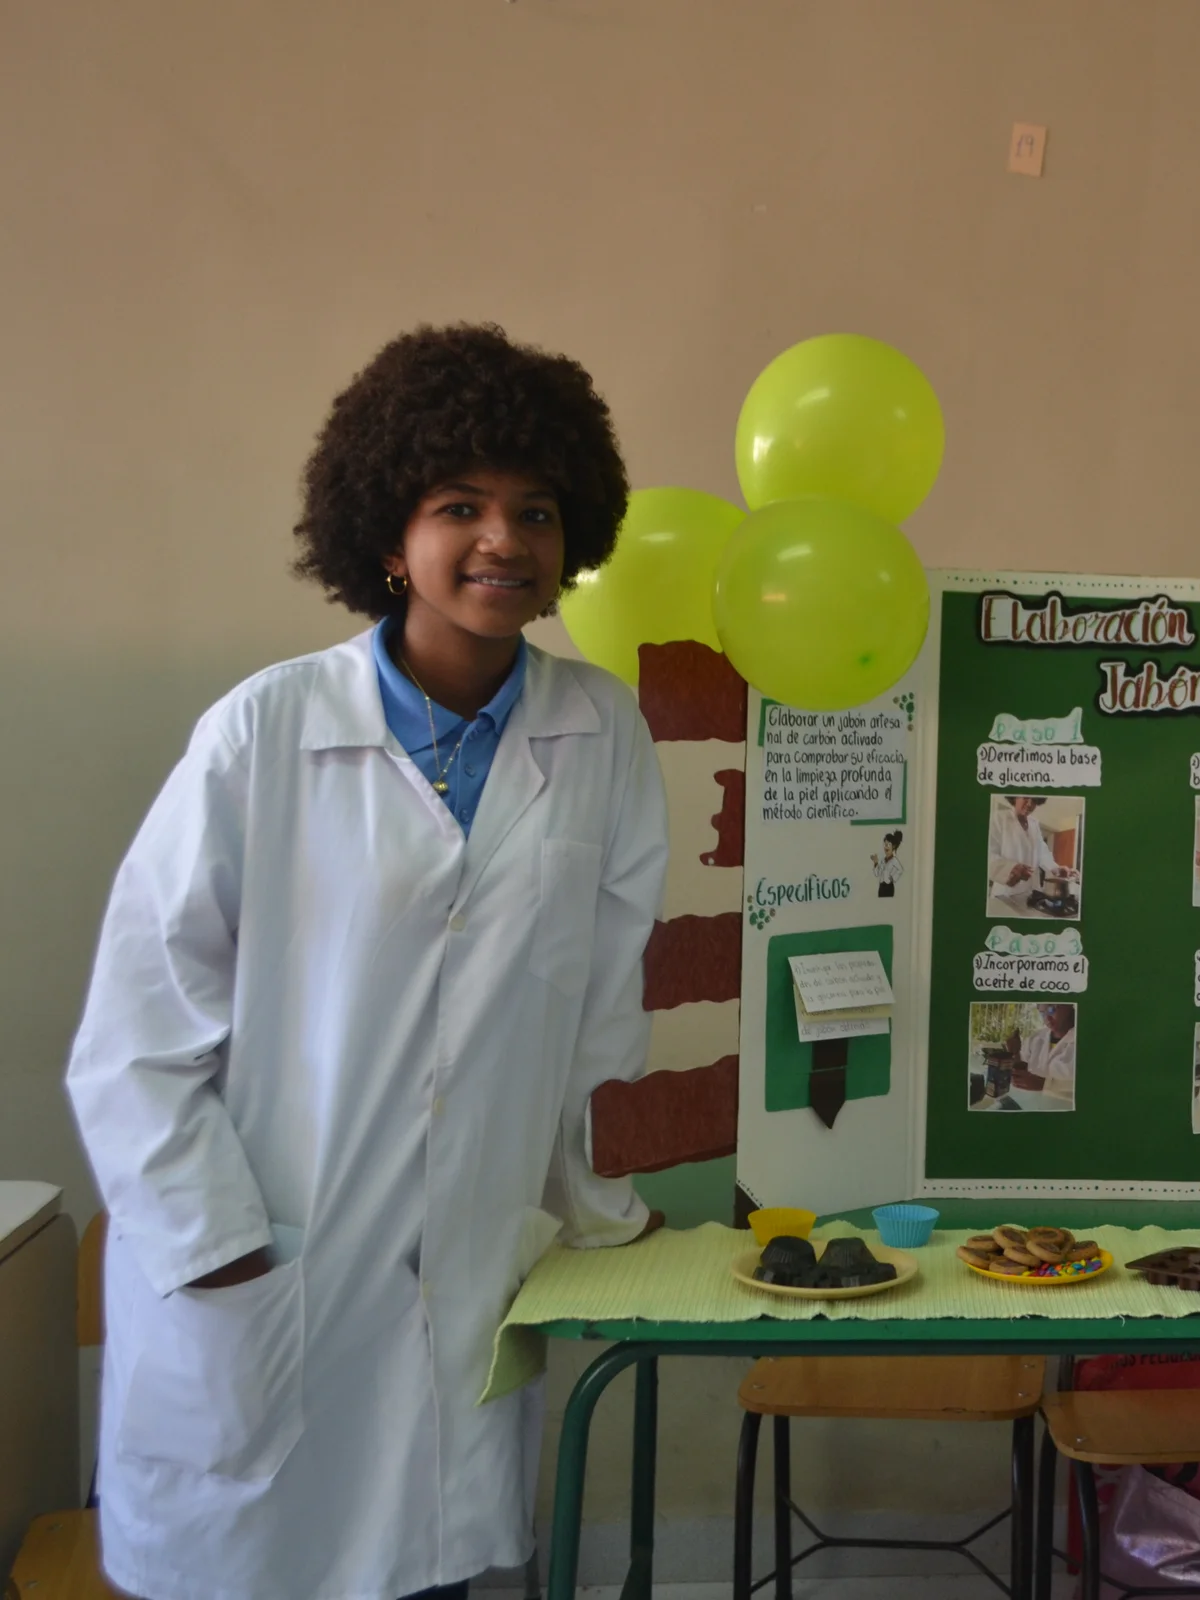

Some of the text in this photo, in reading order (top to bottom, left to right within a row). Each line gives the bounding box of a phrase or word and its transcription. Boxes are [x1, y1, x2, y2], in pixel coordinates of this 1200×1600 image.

[982, 595, 1194, 647] Elaboración
[768, 706, 819, 728] Elaborar
[822, 714, 836, 728] un
[837, 711, 867, 732] jabón
[766, 731, 783, 745] nal
[786, 732, 800, 745] de
[840, 731, 884, 746] activado
[766, 750, 792, 767] para
[866, 749, 905, 765] eficacia
[1056, 749, 1067, 765] la
[1070, 749, 1098, 766] base
[764, 765, 893, 787] en la limpieza profunda
[978, 767, 1055, 786] de glicerina.
[763, 787, 778, 802] de
[783, 786, 794, 801] la
[799, 787, 819, 805] piel
[822, 783, 879, 804] aplicando
[762, 803, 803, 821] método
[1072, 958, 1085, 974] el
[974, 972, 1071, 991] aceite de coco
